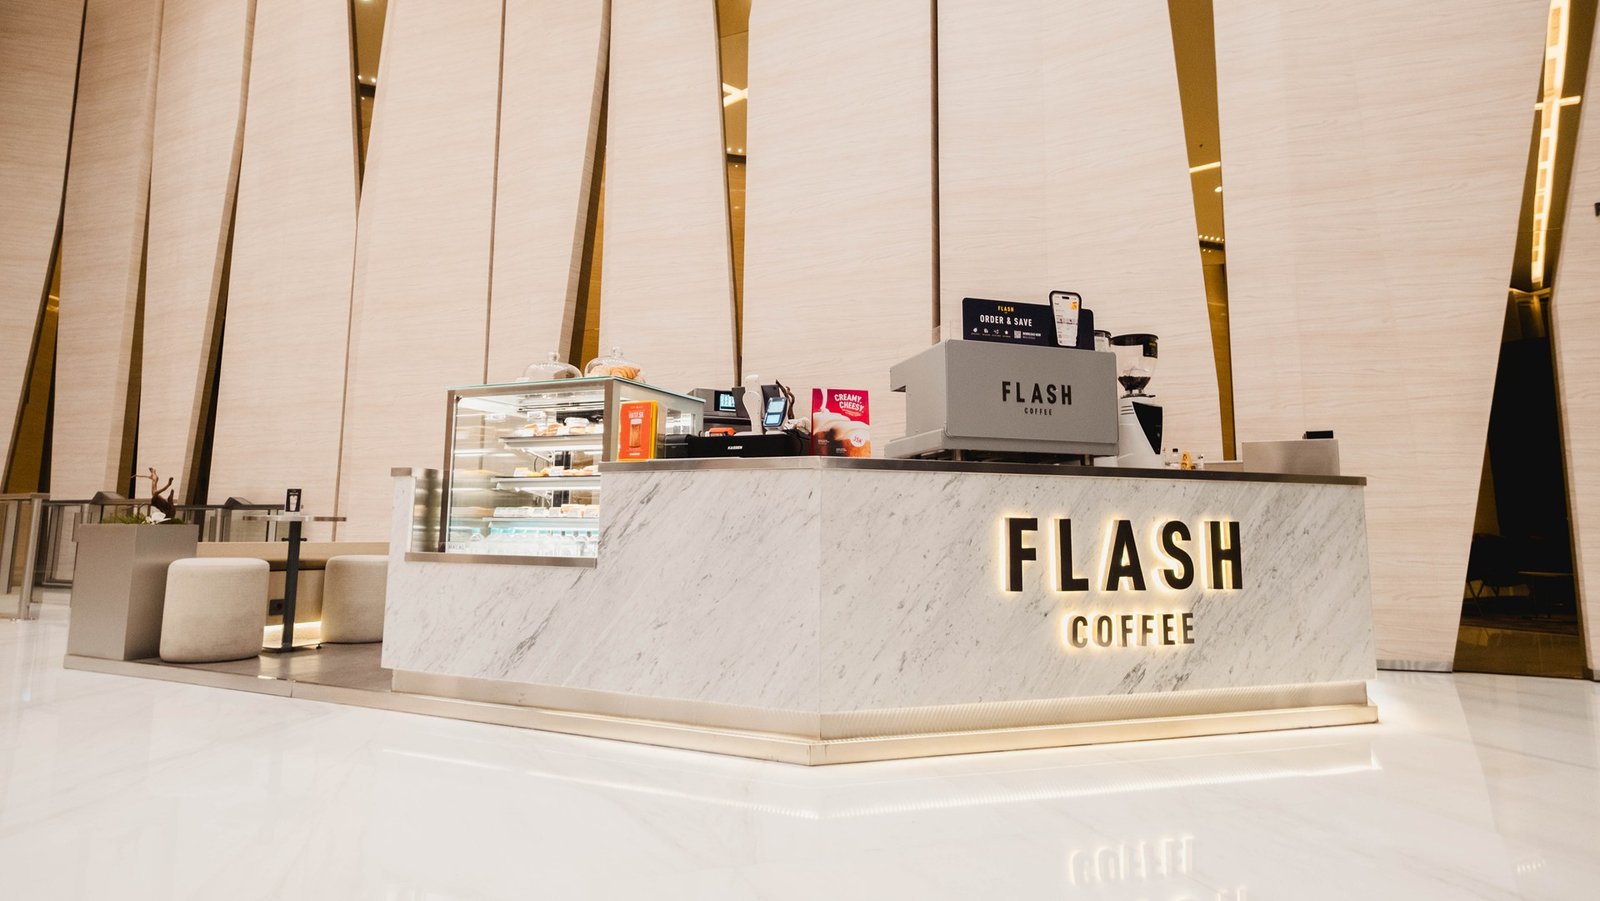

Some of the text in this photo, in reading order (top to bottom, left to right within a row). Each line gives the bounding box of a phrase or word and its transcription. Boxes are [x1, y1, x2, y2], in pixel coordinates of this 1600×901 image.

[980, 314, 1033, 327] ORDER & SAVE
[1002, 381, 1072, 405] FLASH
[1024, 407, 1053, 416] COFFEE
[1004, 517, 1243, 592] FLASH
[1068, 612, 1195, 648] COFFEE
